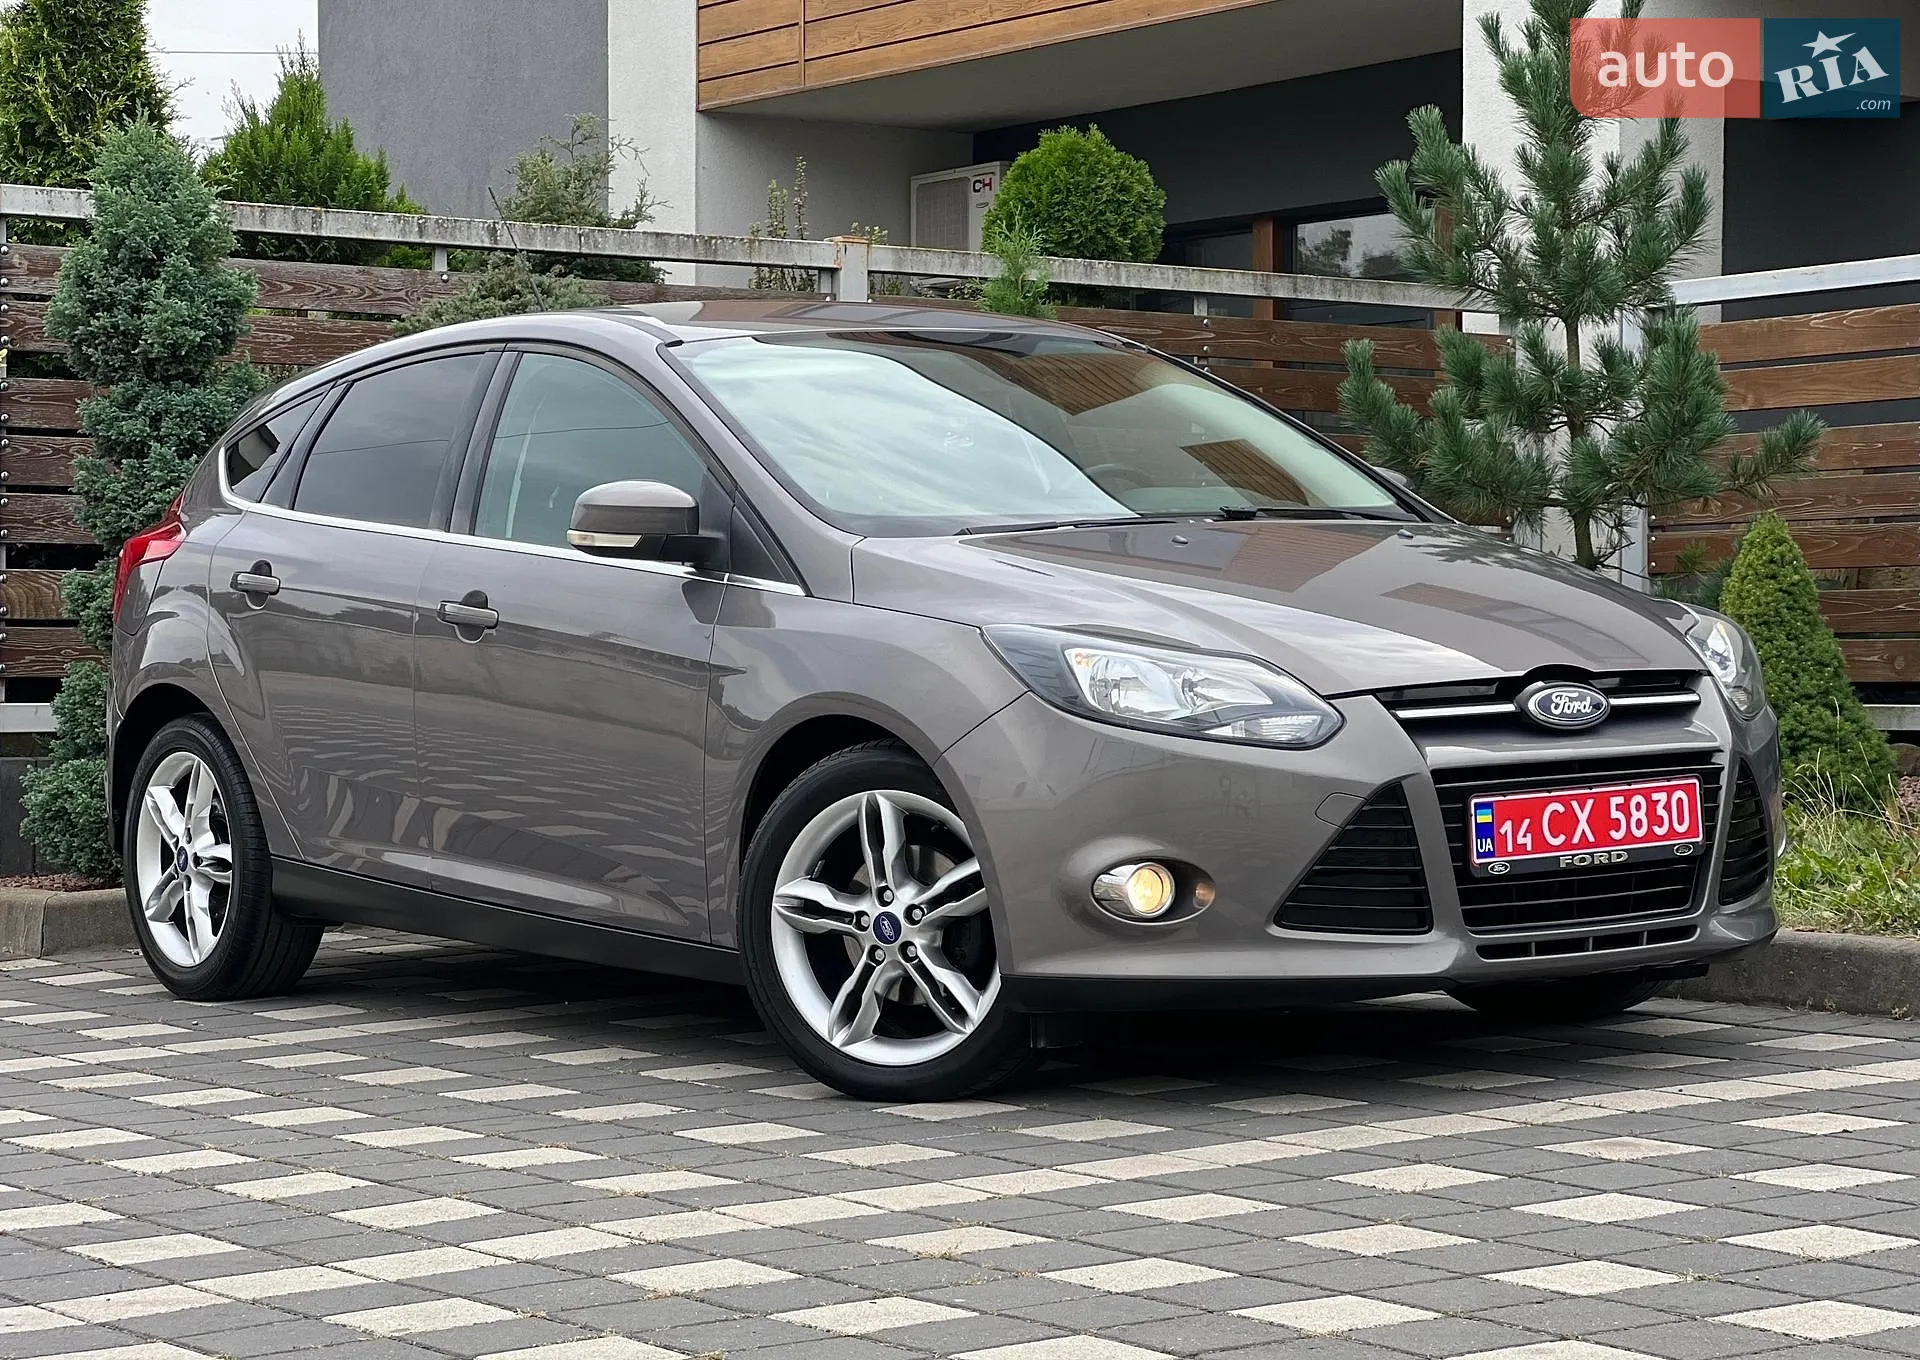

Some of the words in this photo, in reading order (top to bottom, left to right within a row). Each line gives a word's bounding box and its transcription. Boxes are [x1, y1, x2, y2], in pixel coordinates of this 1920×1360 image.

[973, 177, 992, 193] CH
[1551, 691, 1593, 715] Ford
[1499, 818, 1533, 852] 14
[1542, 798, 1596, 846] CX
[1608, 789, 1690, 841] 5830
[1477, 838, 1494, 853] UA
[1559, 851, 1629, 868] FORD
